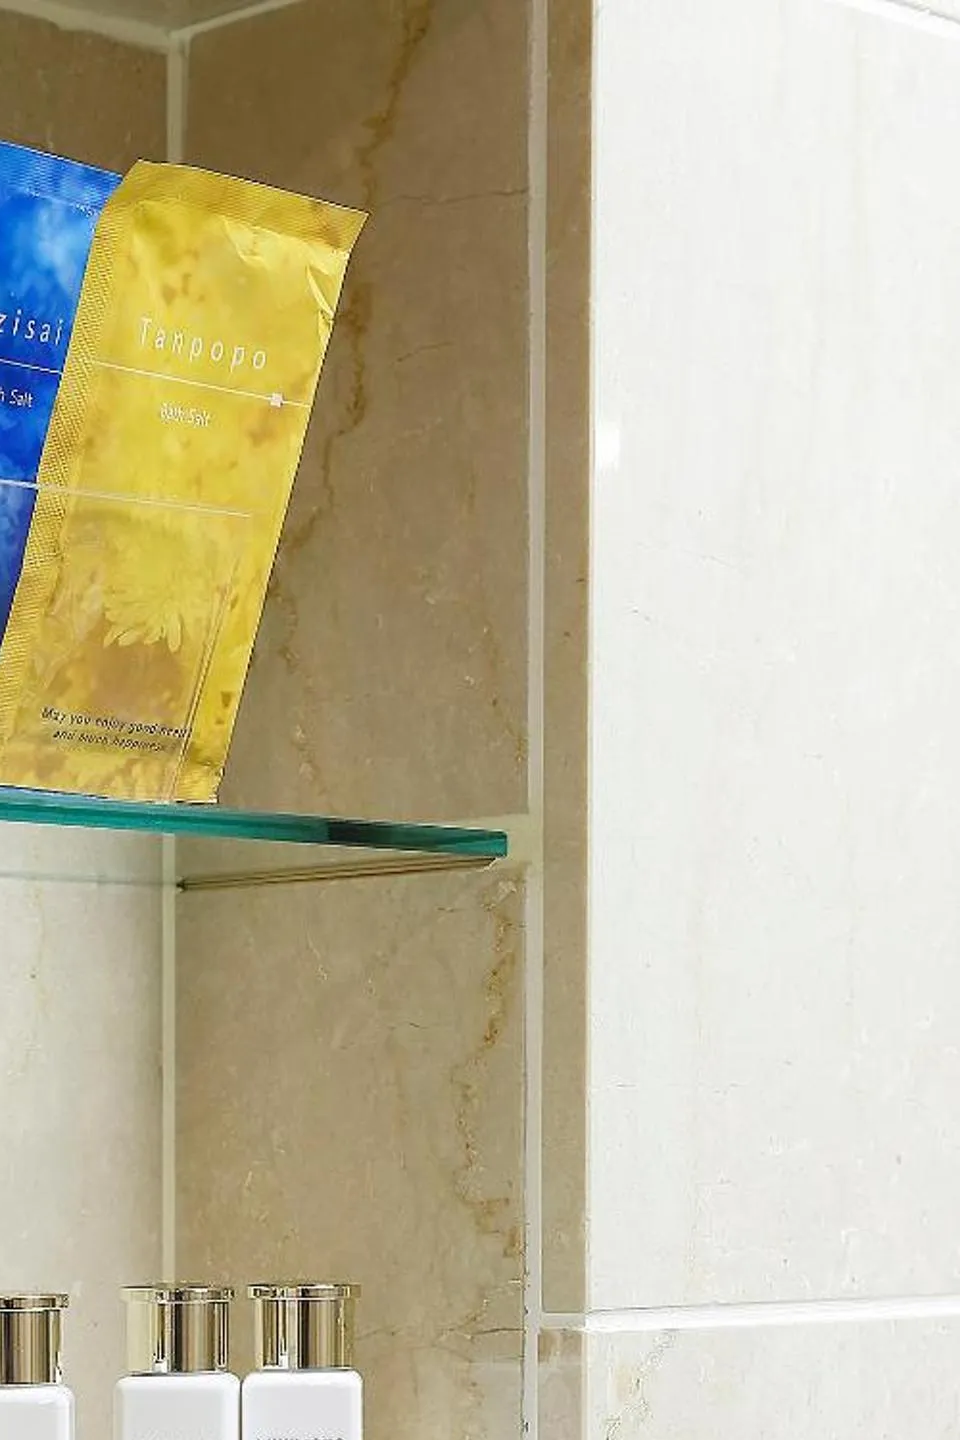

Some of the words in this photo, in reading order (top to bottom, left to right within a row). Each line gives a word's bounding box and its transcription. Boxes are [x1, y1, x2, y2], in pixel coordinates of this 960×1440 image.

[141, 317, 267, 373] Tanpopo
[9, 388, 33, 408] Salt
[40, 706, 66, 725] May
[70, 712, 90, 726] you
